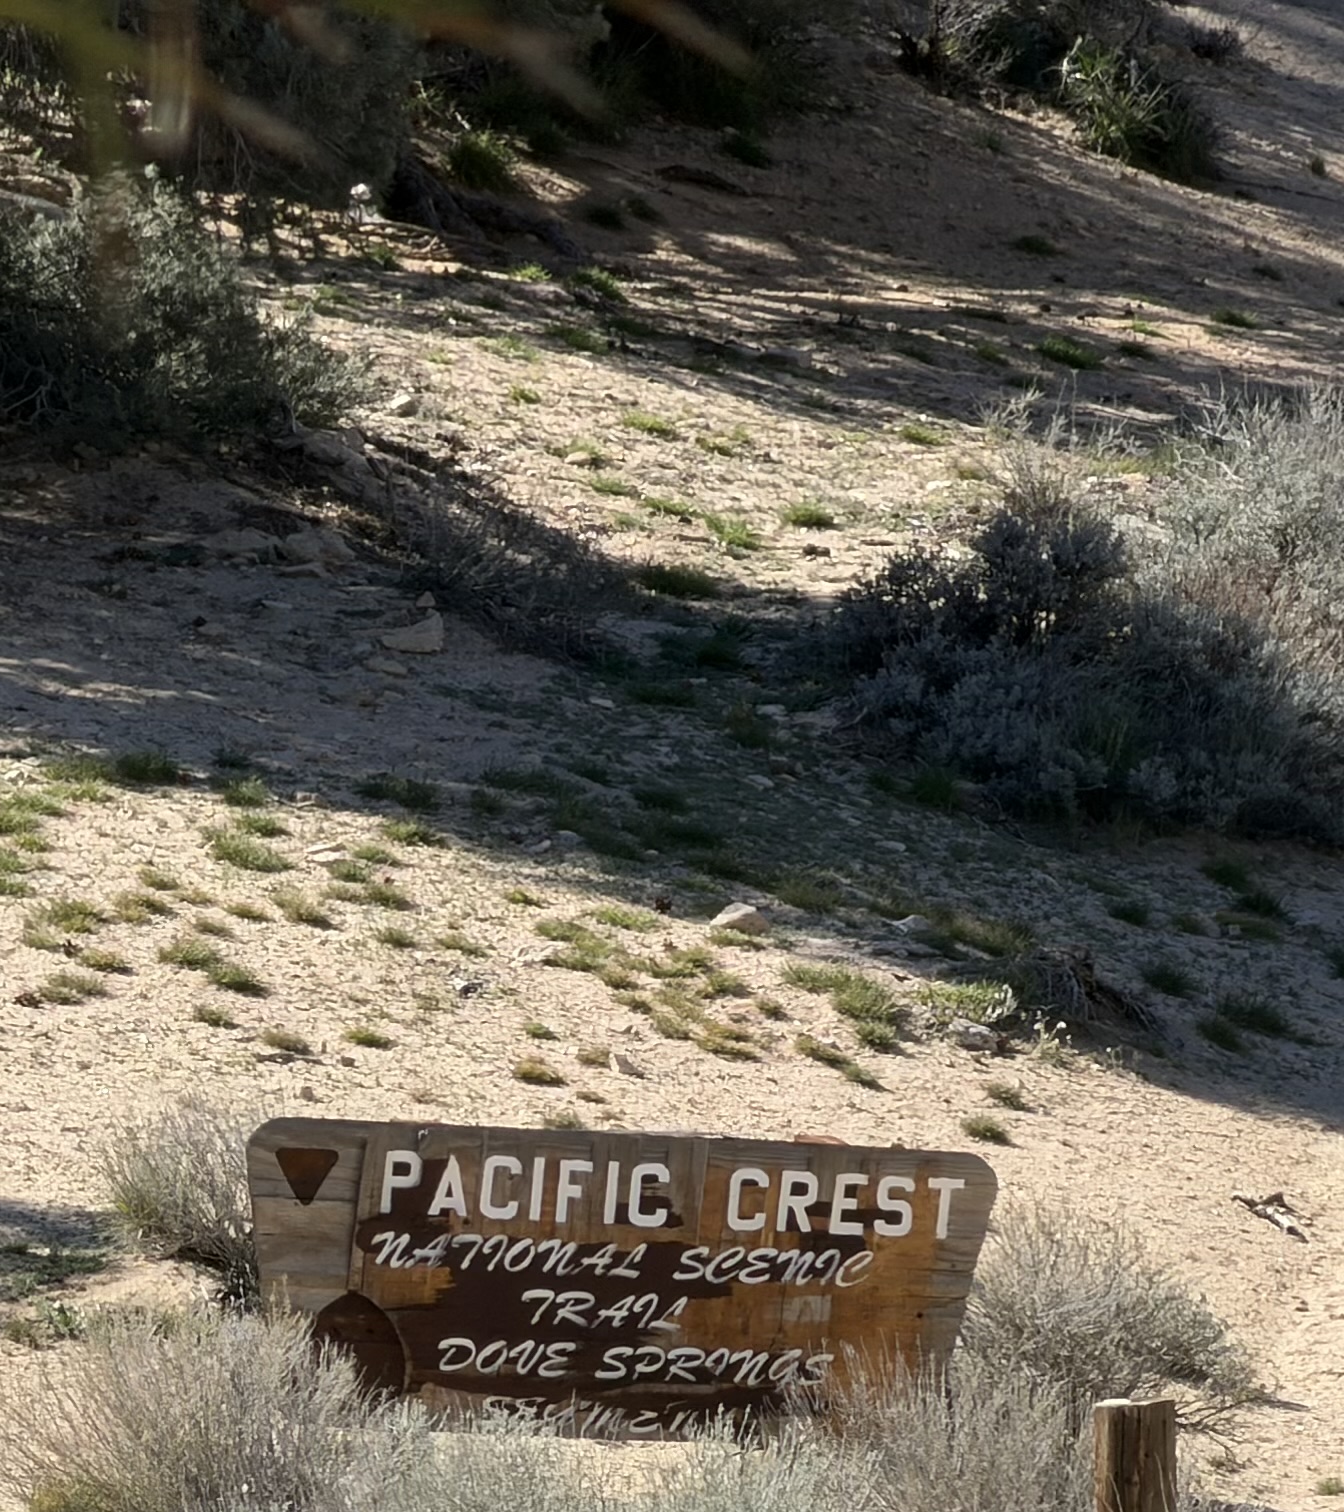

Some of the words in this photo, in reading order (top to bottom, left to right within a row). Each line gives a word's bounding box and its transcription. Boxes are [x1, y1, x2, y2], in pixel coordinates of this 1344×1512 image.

[379, 1150, 671, 1229] PACIFIC
[727, 1167, 966, 1240] CREST
[371, 1232, 644, 1281] NATIONAL
[672, 1247, 874, 1288] SCENIC
[521, 1289, 689, 1332] TRAIL
[437, 1338, 577, 1377] DOVE
[594, 1344, 834, 1387] SPRINGS
